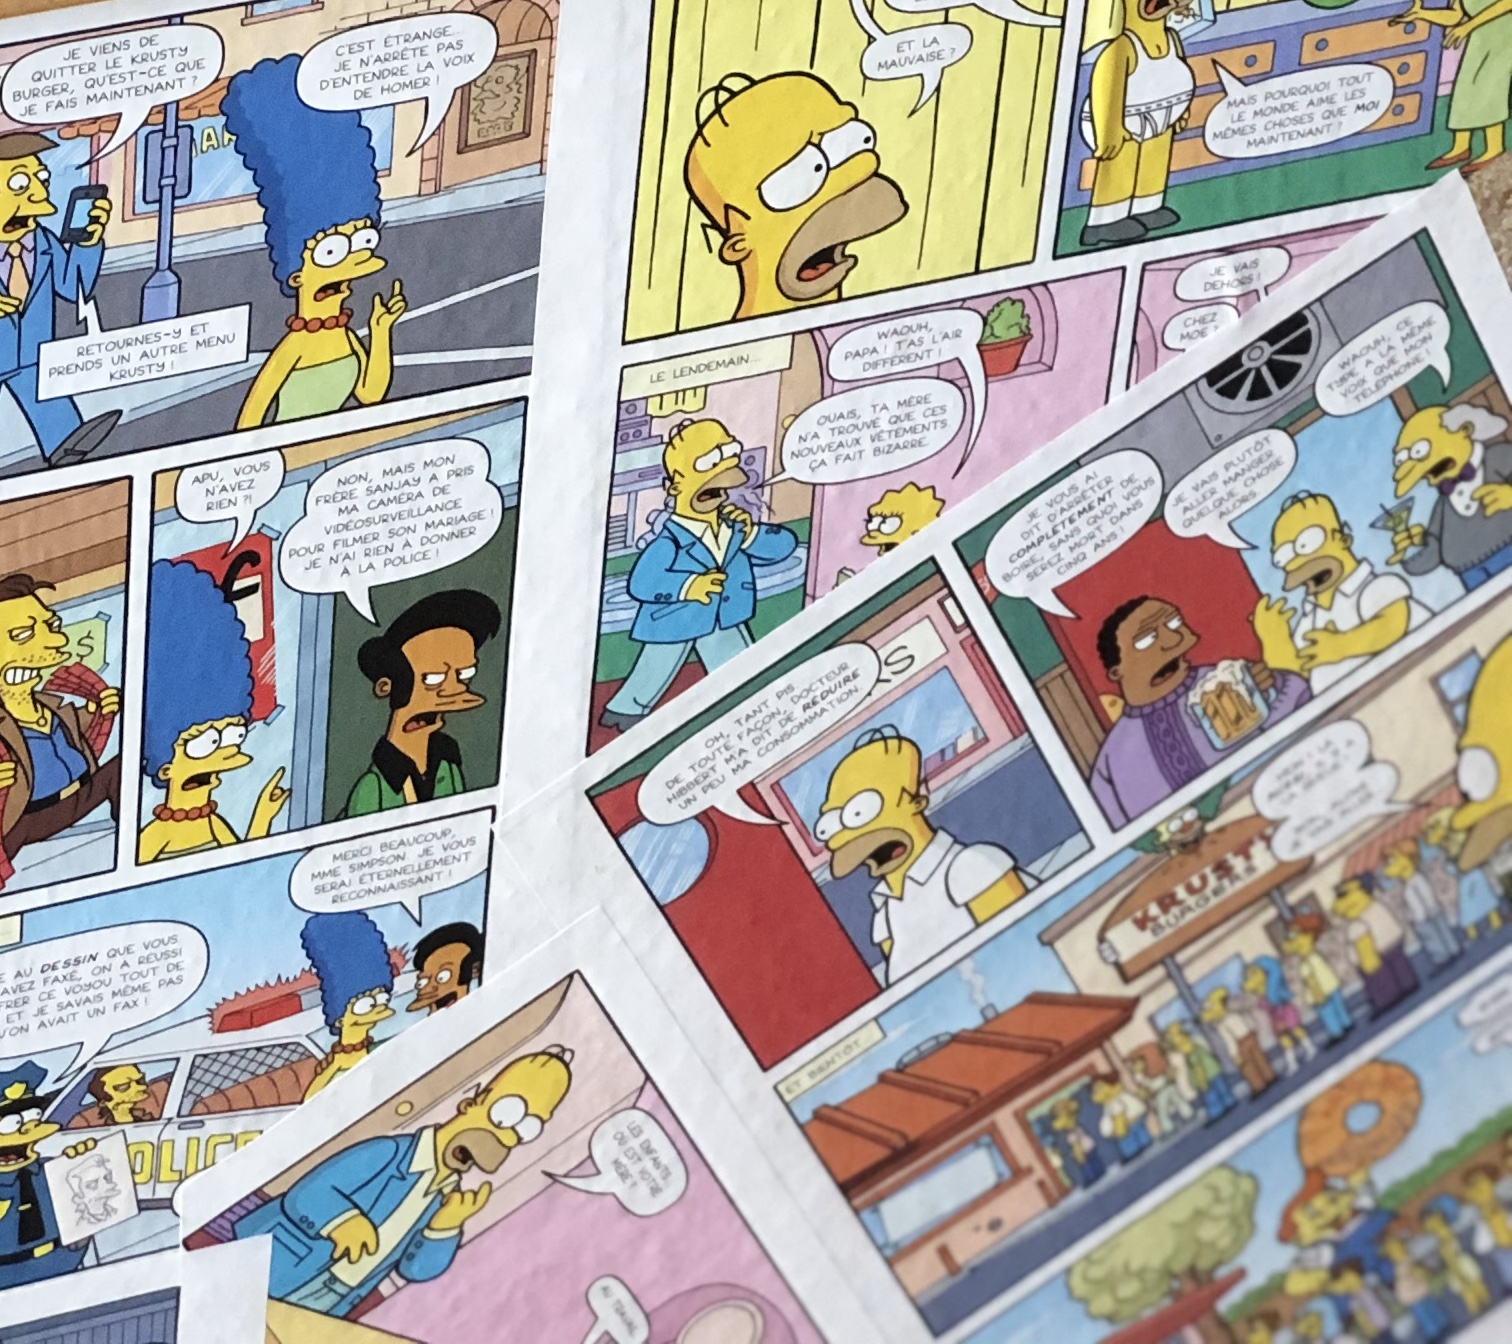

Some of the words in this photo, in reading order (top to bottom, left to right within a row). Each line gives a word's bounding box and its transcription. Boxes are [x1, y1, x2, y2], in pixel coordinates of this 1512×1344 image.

[63, 47, 81, 61] JE
[89, 39, 131, 57] VIENS
[139, 34, 159, 49] DE
[333, 59, 352, 73] JE
[436, 39, 464, 54] PAS
[335, 39, 376, 57] C'EST
[12, 82, 75, 103] BURGER,
[84, 64, 167, 90] QU'EST-CE
[174, 57, 206, 74] QUE
[31, 61, 97, 83] QUITTER
[105, 56, 123, 71] LE
[130, 45, 188, 66] KRUSTY
[319, 64, 409, 91] D'ENTENDRE
[416, 60, 435, 74] LA
[442, 52, 475, 68] VOIX
[19, 103, 38, 117] JE
[45, 97, 78, 113] FAIS
[86, 76, 187, 106] MAINTENANT
[353, 86, 373, 101] DE
[380, 76, 431, 96] HOMER
[1226, 94, 1257, 110] MAIS
[1264, 81, 1331, 103] POURQUOI
[1338, 71, 1374, 87] TOUT
[1230, 110, 1246, 124] LE
[1252, 101, 1299, 120] MONDE
[1306, 93, 1338, 109] AIME
[1344, 87, 1366, 102] LES
[1263, 112, 1314, 132] CHOSES
[1321, 105, 1348, 120] QUE
[1354, 100, 1380, 114] MOI
[1246, 123, 1333, 149] MAINTENANT
[48, 358, 103, 379] PRENDS
[110, 352, 131, 366] UN
[139, 341, 188, 361] AUTRE
[195, 332, 236, 350] MENU
[76, 328, 182, 358] RETOURNES-Y
[190, 322, 210, 337] ET
[109, 361, 166, 382] KRUSTY
[649, 371, 666, 384] LE
[191, 470, 224, 486] APU,
[233, 460, 271, 477] VOUS
[205, 478, 255, 498] N'AVEZ
[206, 496, 238, 512] RIEN
